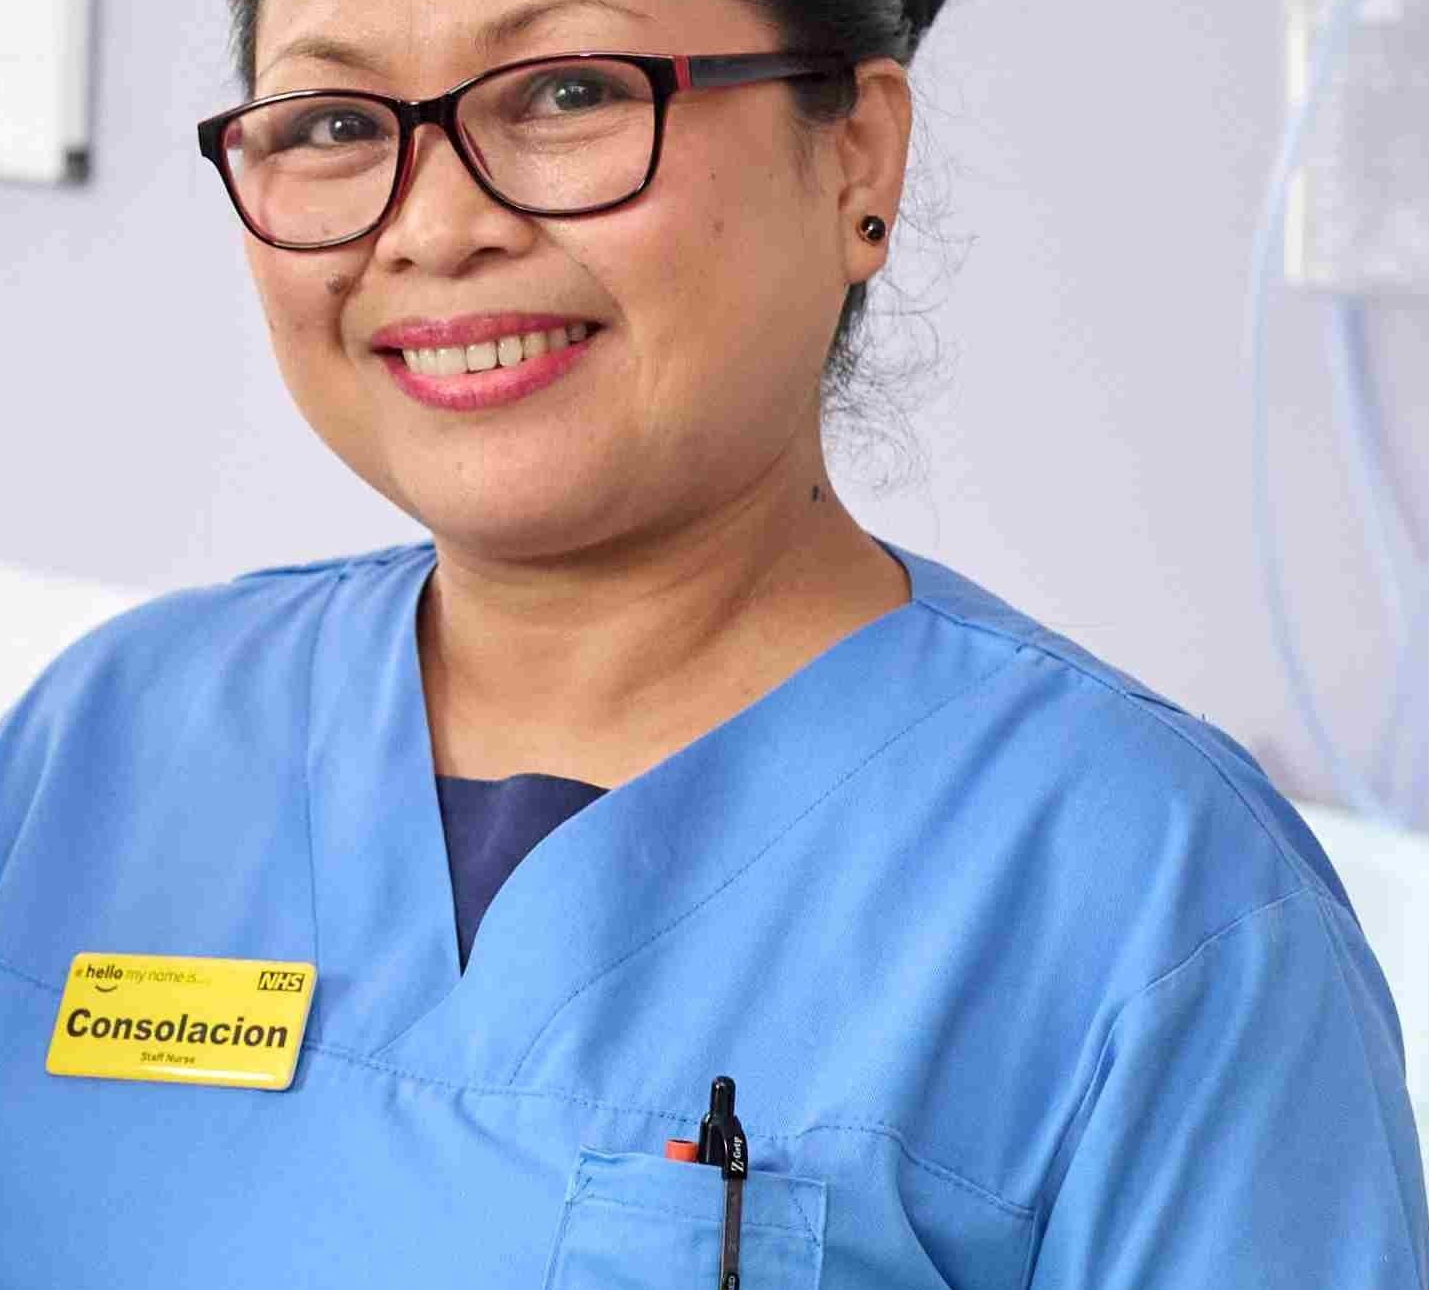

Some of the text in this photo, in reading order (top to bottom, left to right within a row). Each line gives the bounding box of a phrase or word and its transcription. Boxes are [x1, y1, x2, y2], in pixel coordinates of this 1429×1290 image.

[148, 971, 184, 983] name
[258, 971, 304, 991] NHS
[66, 1008, 289, 1048] Consolacion
[140, 1051, 164, 1063] Staff
